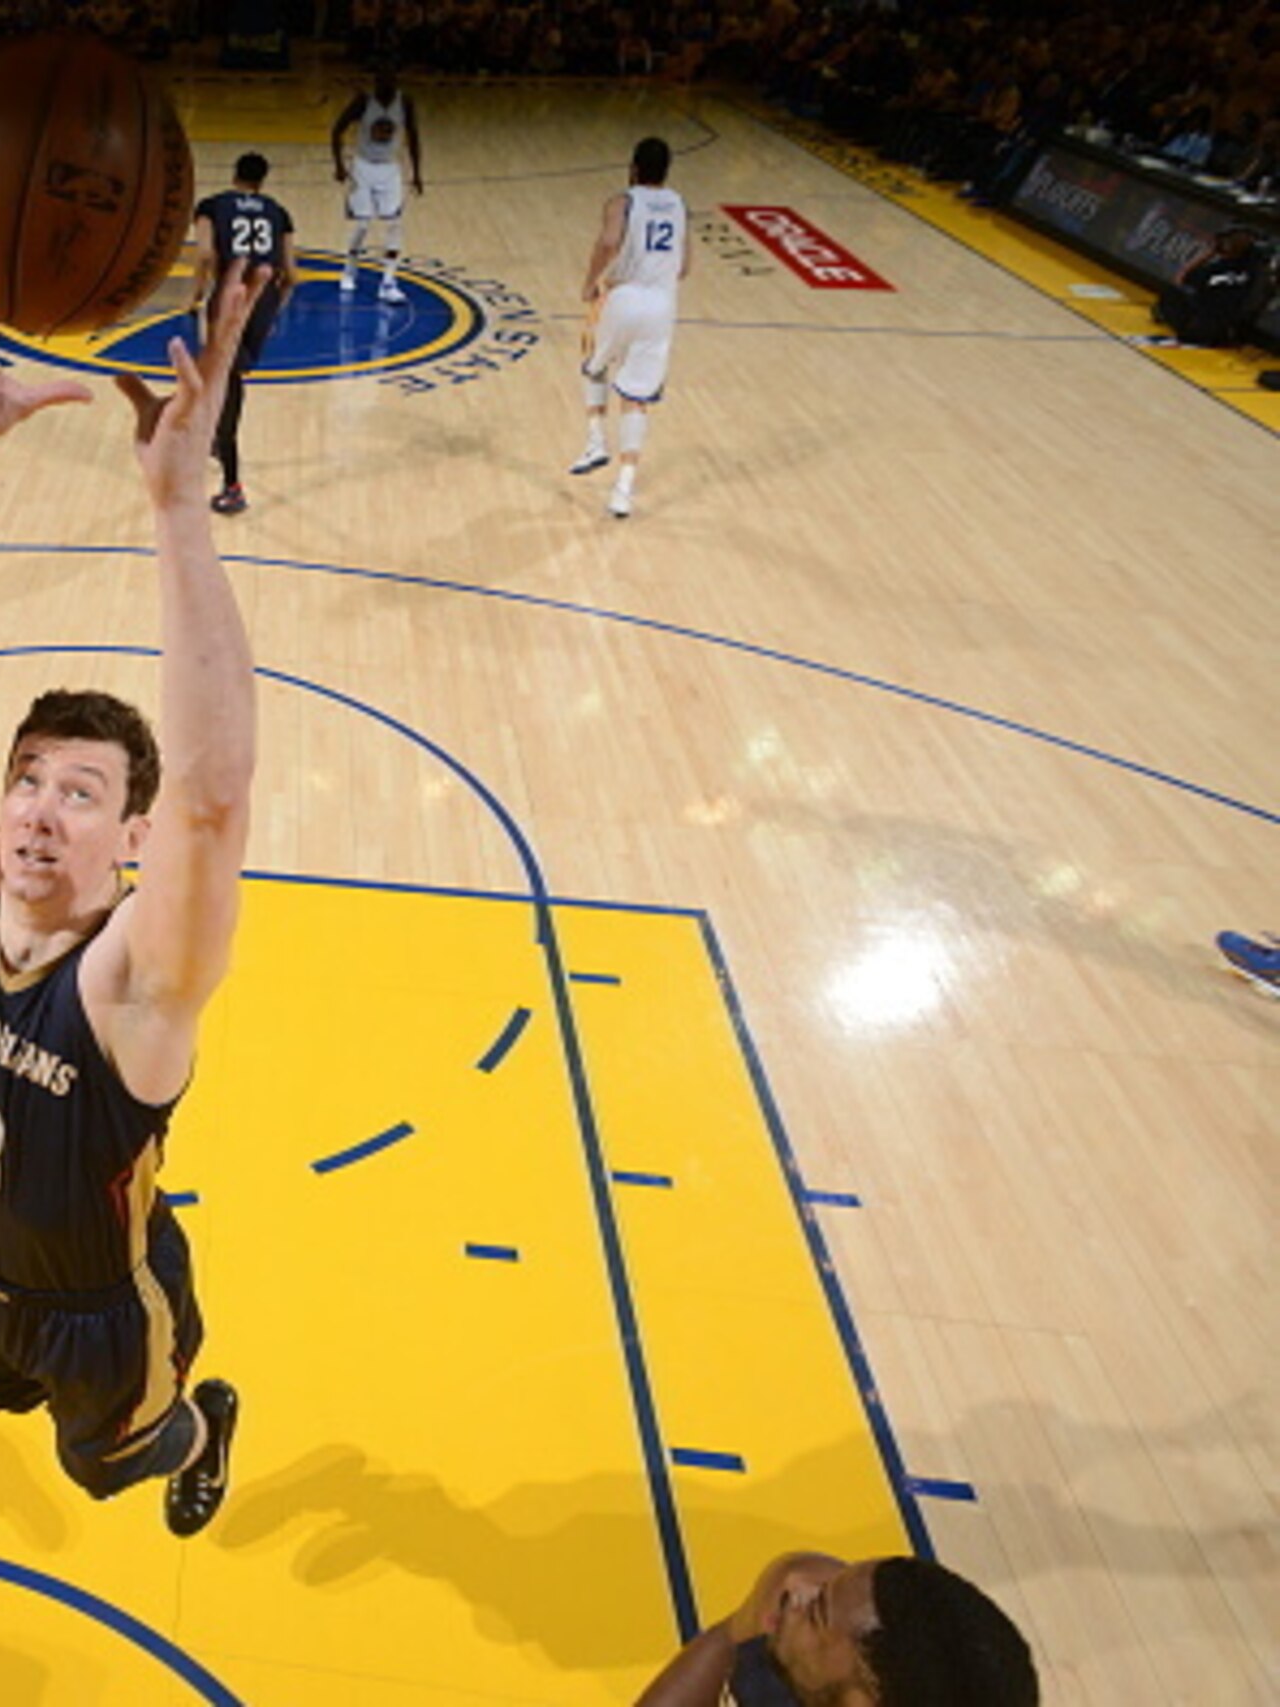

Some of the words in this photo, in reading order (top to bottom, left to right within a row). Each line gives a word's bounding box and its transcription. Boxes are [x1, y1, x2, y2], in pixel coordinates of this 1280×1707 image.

[231, 216, 273, 256] 23
[646, 219, 673, 252] 12
[745, 209, 868, 282] ORACLE
